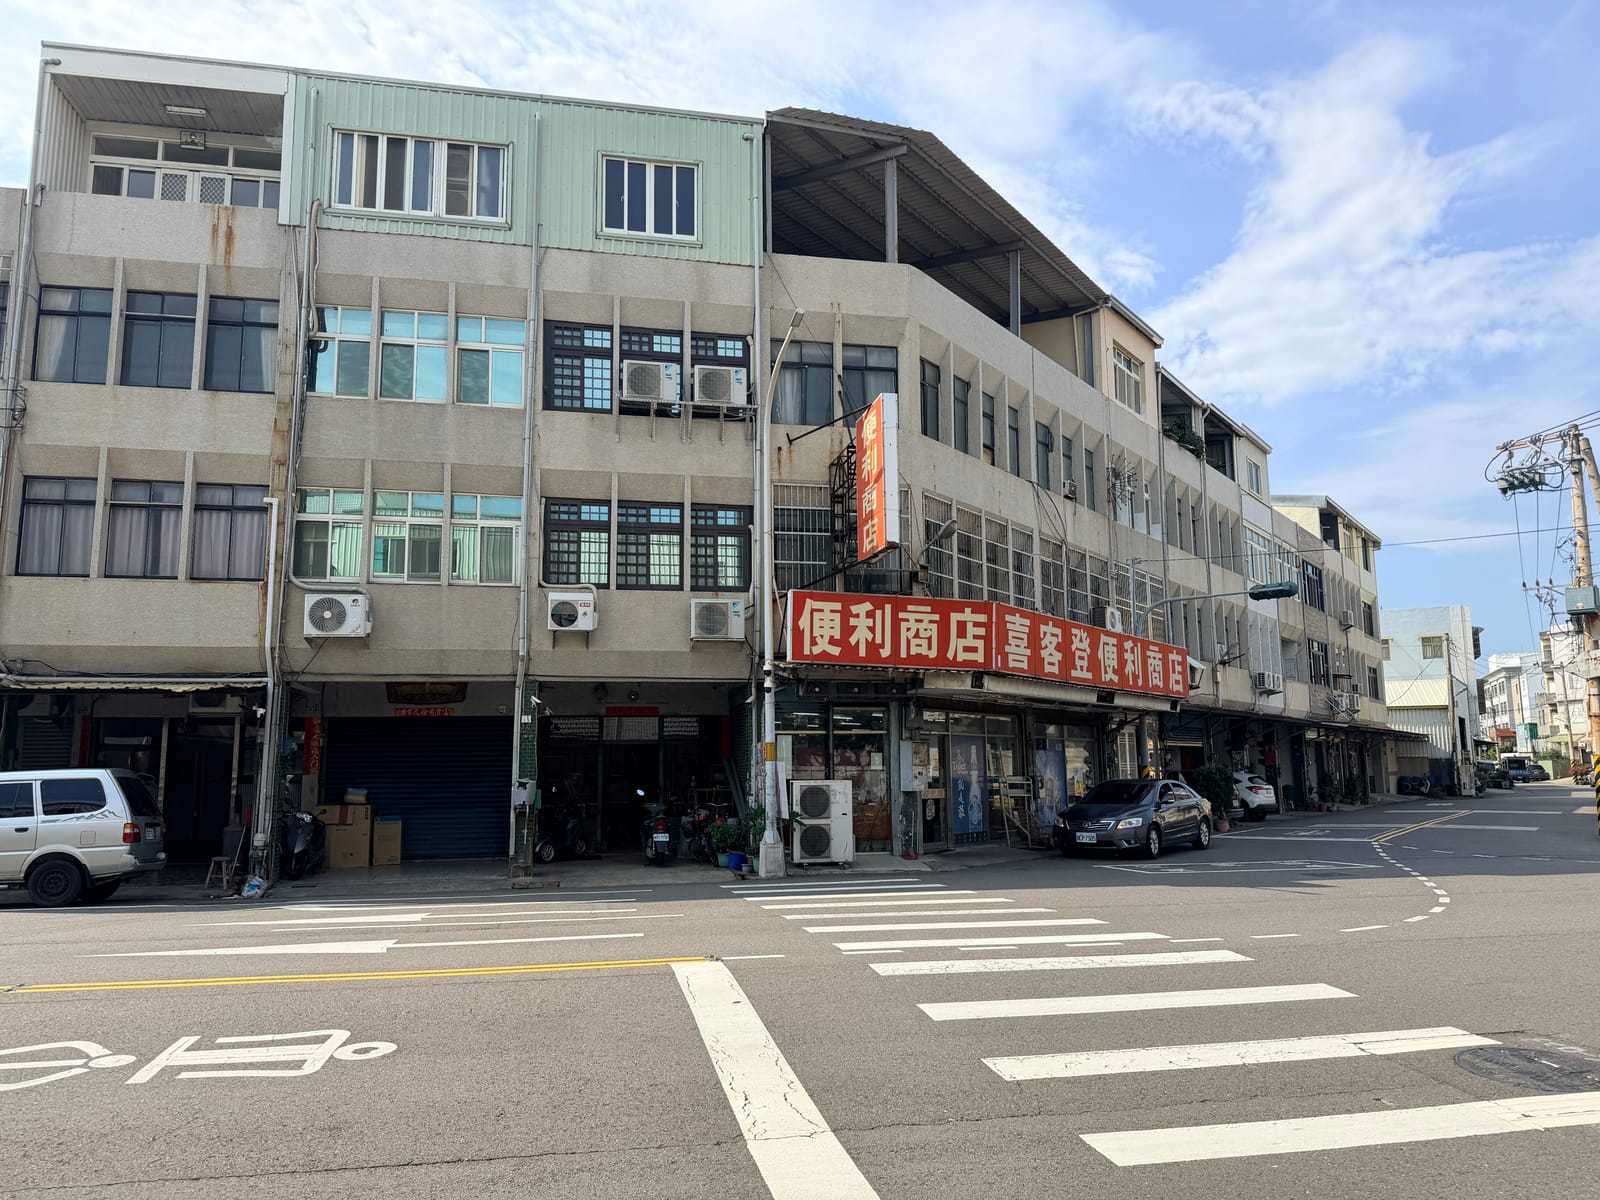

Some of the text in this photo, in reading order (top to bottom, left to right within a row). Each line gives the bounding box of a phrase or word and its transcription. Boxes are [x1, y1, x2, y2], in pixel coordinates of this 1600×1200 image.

[862, 410, 878, 553] 便利商店
[798, 599, 988, 663] 便利商店
[1005, 613, 1184, 692] 喜客登便利商店
